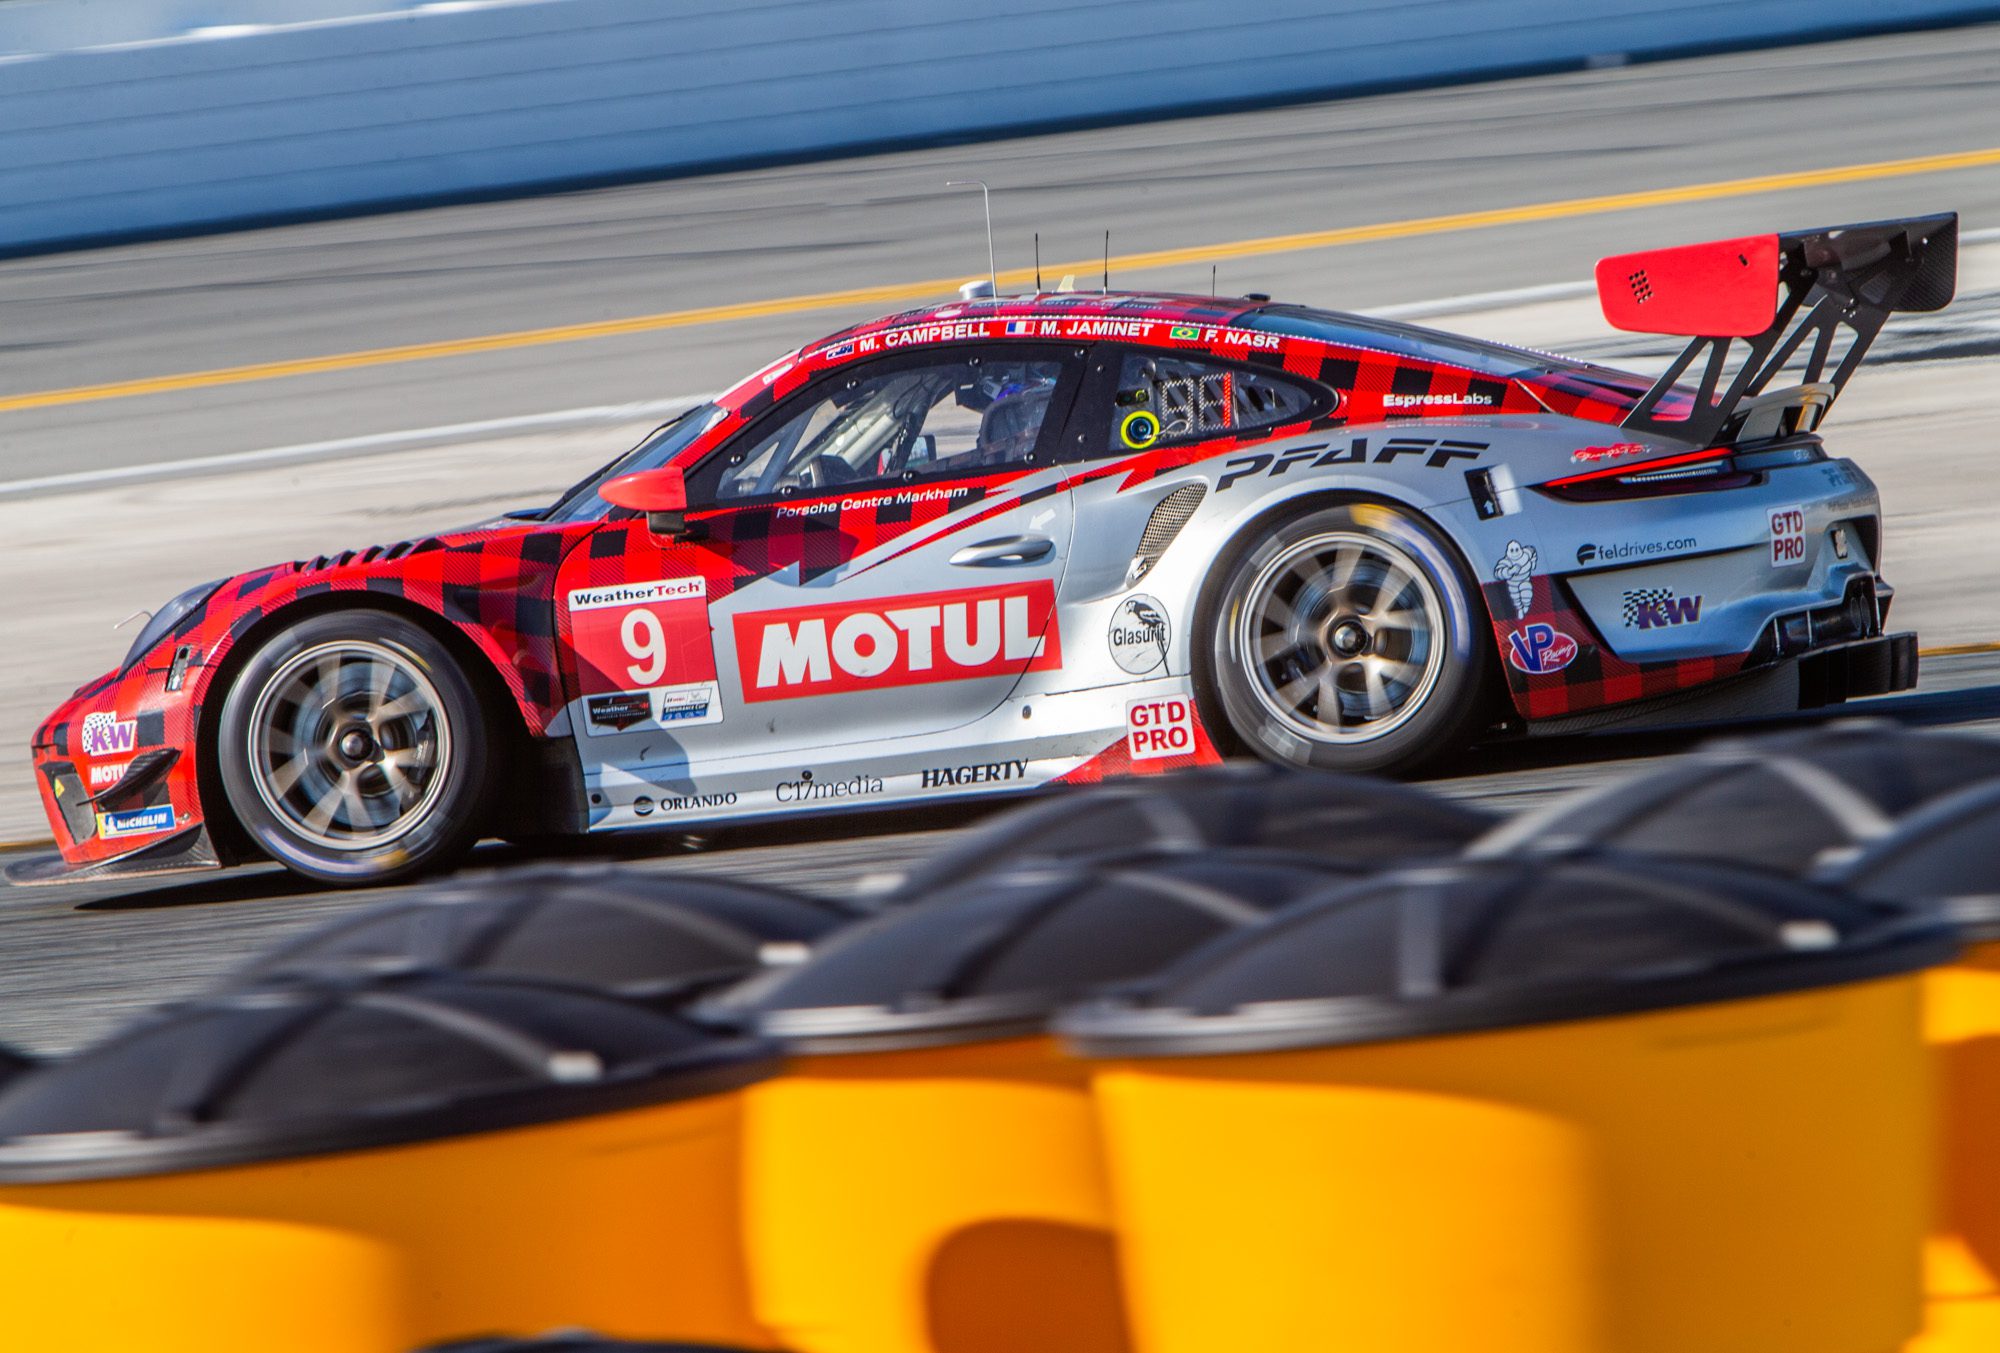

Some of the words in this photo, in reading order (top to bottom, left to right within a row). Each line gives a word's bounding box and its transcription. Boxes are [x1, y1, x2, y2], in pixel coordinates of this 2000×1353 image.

[859, 338, 881, 352] M.
[885, 323, 991, 348] CAMPBELL
[1040, 322, 1062, 336] M.
[1066, 322, 1154, 337] JAMINET
[1204, 329, 1219, 343] F.
[1224, 332, 1280, 349] NASR
[1383, 393, 1492, 408] EspressLabs
[1215, 438, 1490, 493] PFAFF
[776, 501, 837, 518] Porsche
[840, 495, 892, 511] Centre
[896, 487, 969, 504] Markham
[1771, 510, 1804, 535] GTD
[1599, 537, 1697, 561] feldrives.com
[1773, 535, 1804, 562] PRO
[574, 582, 700, 606] WeatherTech
[1636, 595, 1703, 629] KW
[620, 608, 667, 685] 9
[756, 595, 1046, 688] MOTUL
[1113, 625, 1166, 647] Glasurit
[1509, 624, 1555, 672] VP
[1130, 701, 1186, 727] GTD
[91, 722, 134, 752] KW
[1133, 726, 1189, 753] PRO
[91, 764, 129, 784] MOTU
[921, 758, 1029, 789] HAGERTY
[660, 792, 738, 812] ORLANDO
[776, 775, 884, 803] C17media
[117, 813, 167, 829] MICHELIN
